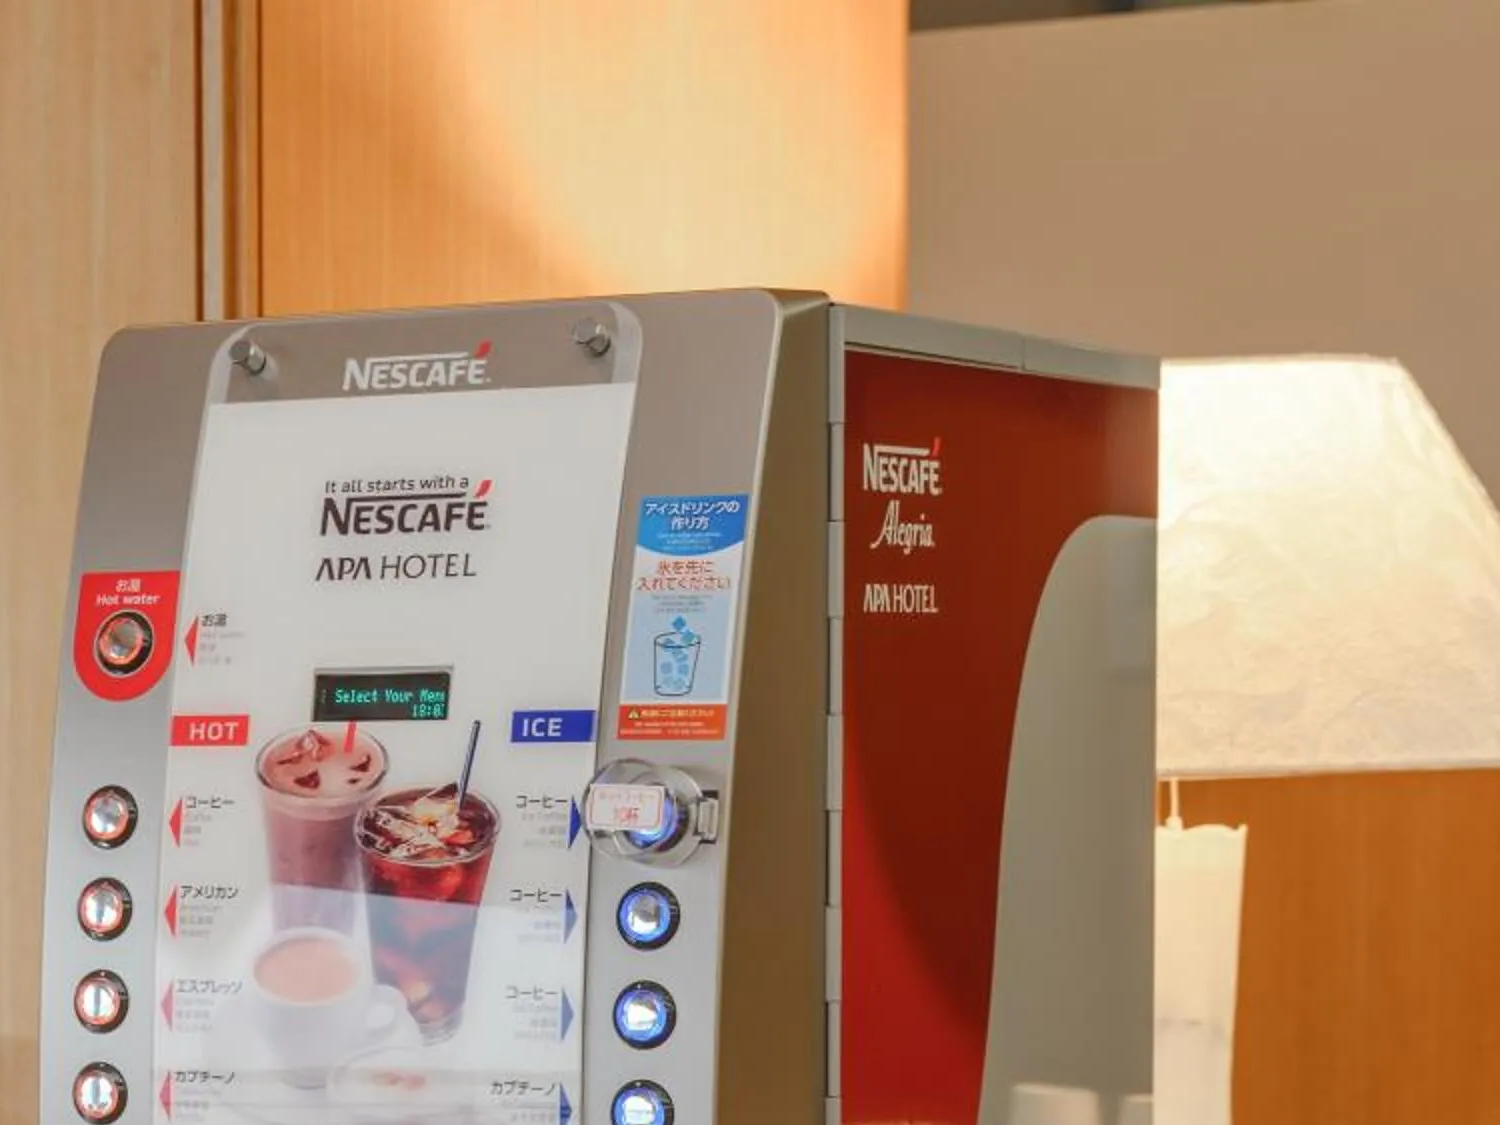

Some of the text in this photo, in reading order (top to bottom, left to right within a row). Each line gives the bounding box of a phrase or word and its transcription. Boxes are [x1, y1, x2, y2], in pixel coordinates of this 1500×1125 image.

[342, 340, 492, 391] NESCAFÉ
[863, 437, 943, 496] NESCAFÉ
[325, 475, 469, 493] It all starts with a
[320, 479, 493, 536] NESCAFÉ
[644, 499, 741, 516] アイスドリンクの
[671, 516, 710, 531] 作り方
[869, 499, 936, 556] Alegria
[315, 553, 477, 581] APA HOTEL
[96, 592, 161, 606] Hot water
[863, 583, 939, 613] APA HOTEL
[334, 688, 378, 703] Select
[384, 687, 414, 703] Your
[189, 720, 239, 741] HOT
[522, 717, 563, 737] ICE
[184, 795, 236, 809] コーヒー
[515, 794, 568, 809] コーヒー
[179, 884, 239, 899] アメリカン
[509, 887, 562, 903] コーヒー
[504, 984, 558, 1001] コーヒー
